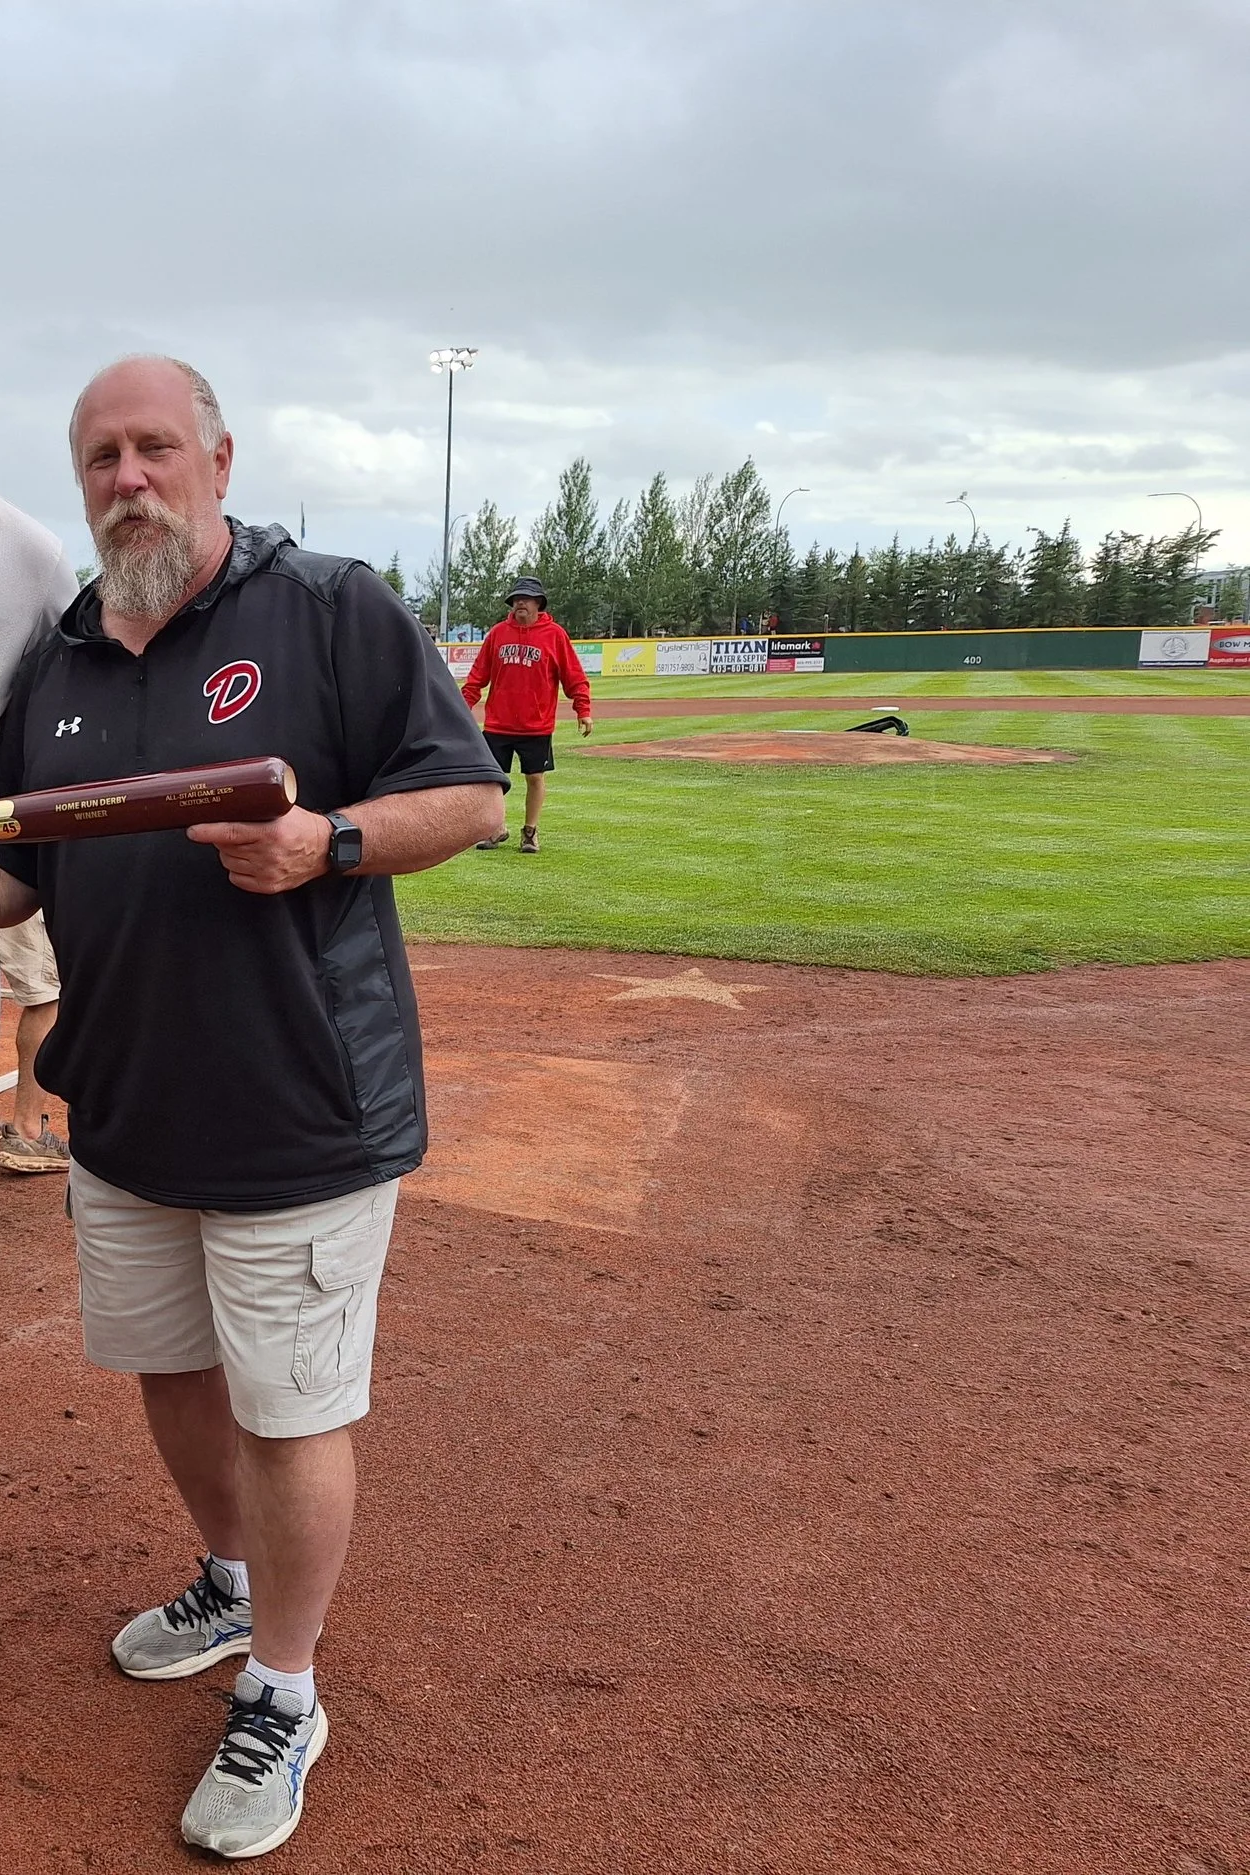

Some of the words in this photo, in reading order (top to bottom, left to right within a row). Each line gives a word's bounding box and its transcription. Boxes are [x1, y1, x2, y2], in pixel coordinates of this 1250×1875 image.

[713, 640, 767, 655] TITAN
[771, 640, 811, 651] lifemark
[499, 643, 542, 663] OKOTOKS
[713, 655, 737, 663] WATER
[737, 655, 742, 663] &
[742, 654, 767, 663] SEPTIC
[963, 656, 982, 665] 400
[712, 664, 766, 673] 403-601-0811
[202, 659, 263, 725] D
[165, 791, 197, 801] ALL-STAR
[197, 789, 216, 797] GAME
[217, 786, 234, 795] 2025
[55, 801, 80, 812] HOME
[80, 799, 99, 809] RUN
[99, 795, 127, 806] DERBY
[74, 809, 108, 821] WINNER
[2, 821, 17, 833] 45
